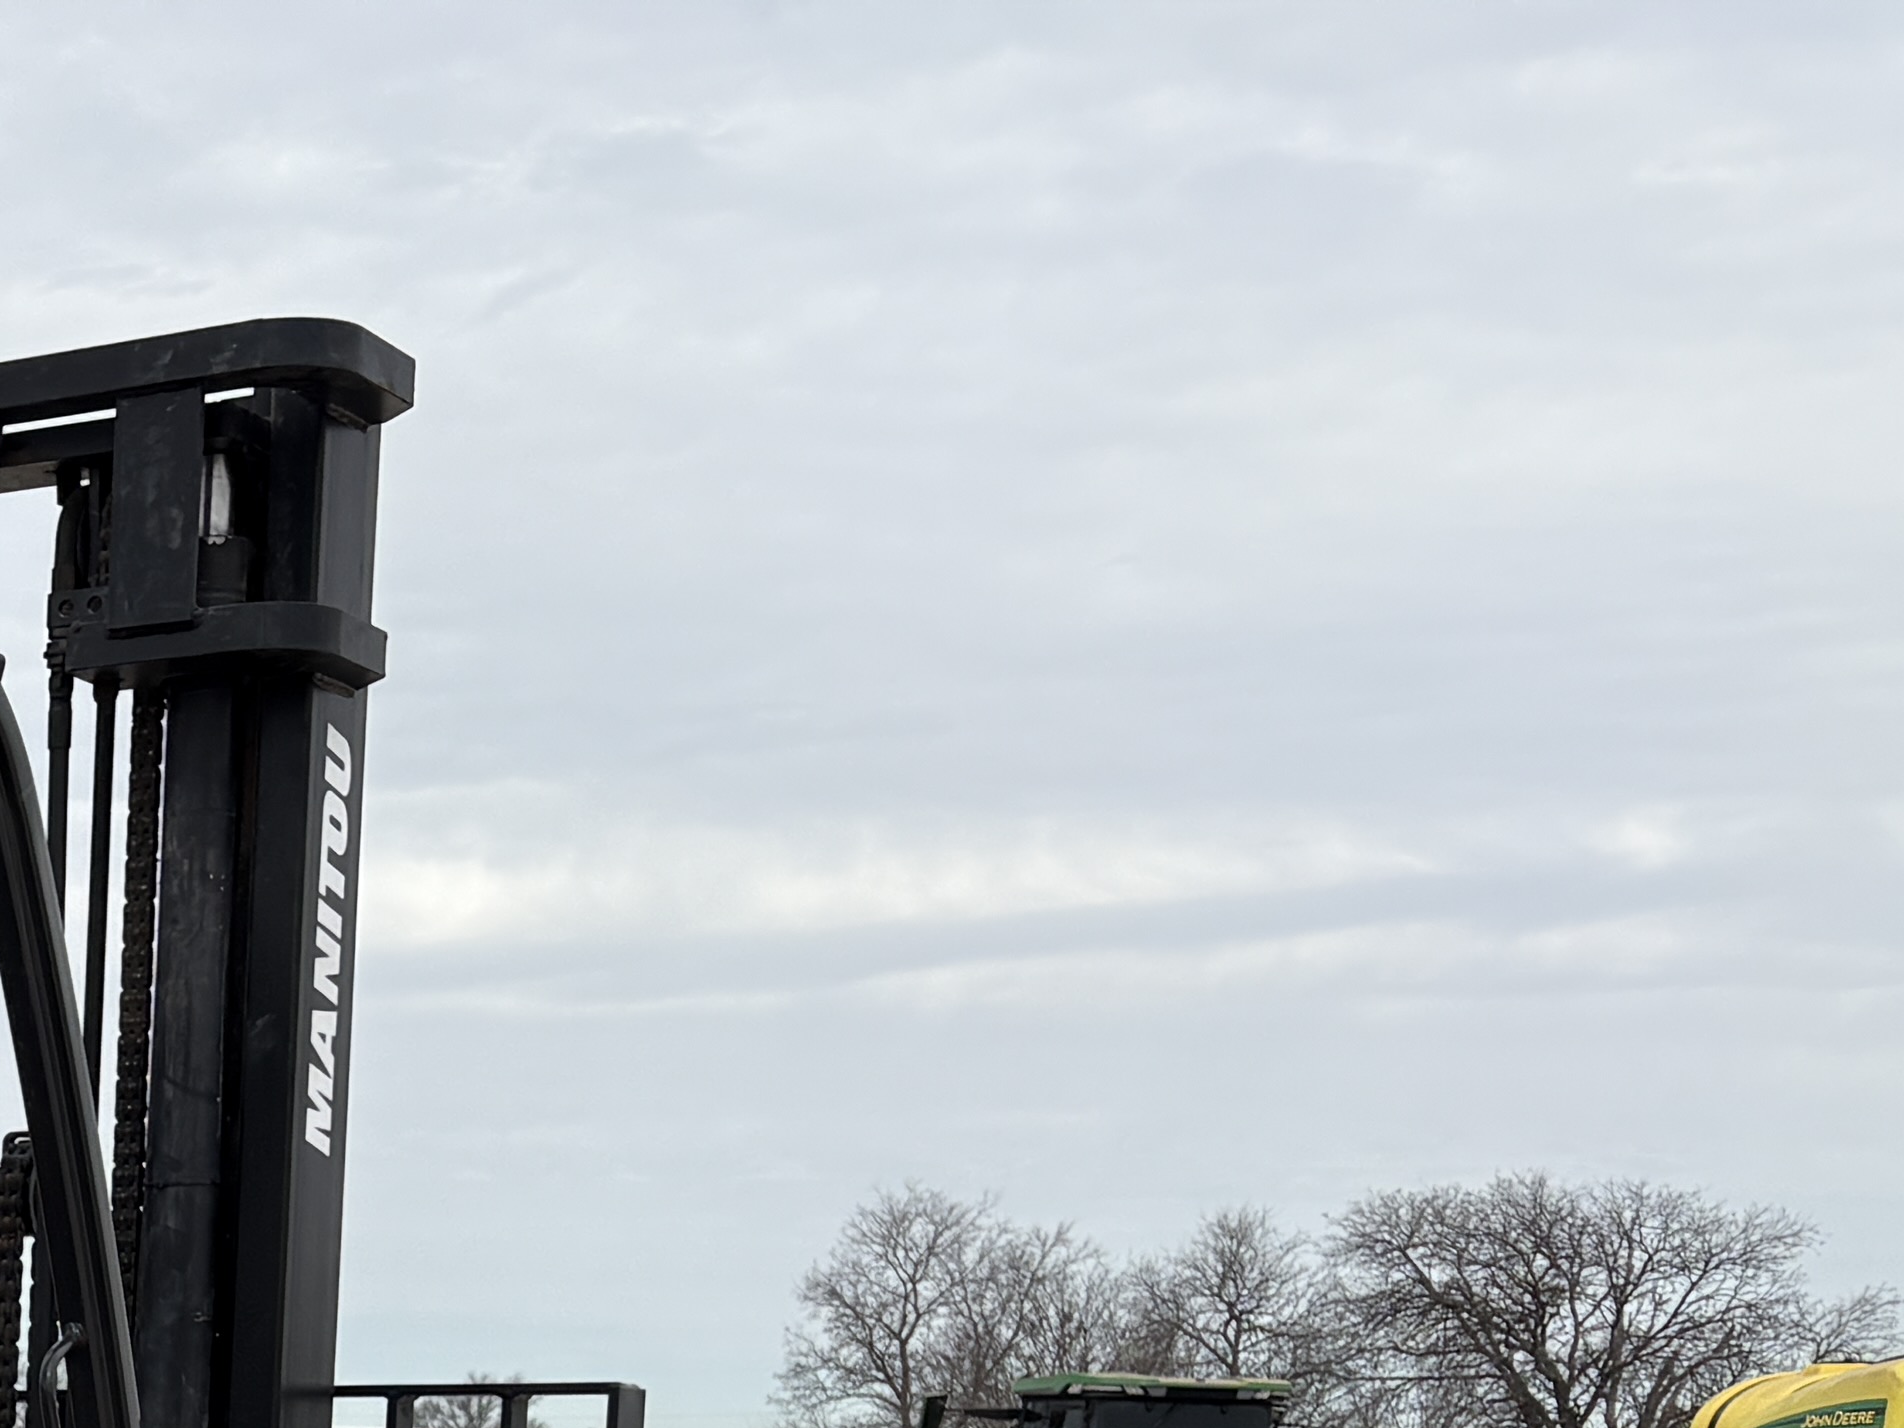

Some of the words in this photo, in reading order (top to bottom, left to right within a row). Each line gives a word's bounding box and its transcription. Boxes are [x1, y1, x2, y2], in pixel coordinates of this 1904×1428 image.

[304, 722, 357, 1158] MANITOU
[1800, 1413, 1832, 1428] JOHN
[1832, 1410, 1876, 1426] DEERE
